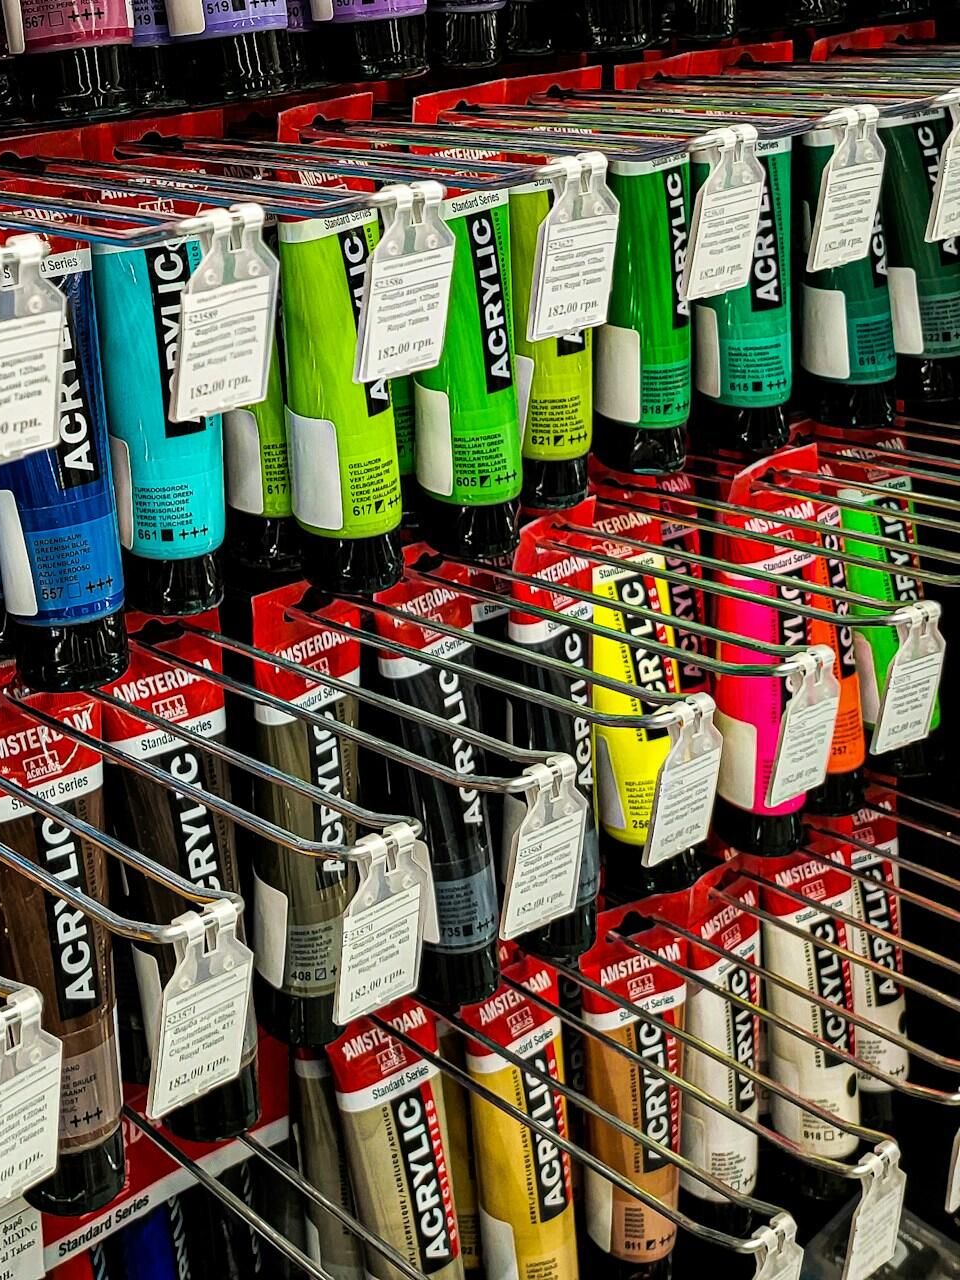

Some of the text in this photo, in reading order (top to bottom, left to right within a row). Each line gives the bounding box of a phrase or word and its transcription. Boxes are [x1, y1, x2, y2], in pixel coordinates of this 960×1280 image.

[207, 1, 229, 14] 519
[471, 217, 511, 379] ACRYLIC
[532, 435, 550, 446] 621
[353, 504, 372, 516] 617
[138, 529, 157, 540] 661
[291, 969, 311, 982] 408
[371, 1064, 430, 1101] Standard Series
[803, 1130, 823, 1141] 818
[397, 1096, 450, 1259] ACRYLIC
[426, 1100, 458, 1241] SPECIALTIES
[3, 1221, 39, 1247] MIXING
[58, 1193, 150, 1258] Standard Series
[10, 1239, 36, 1259] Talens
